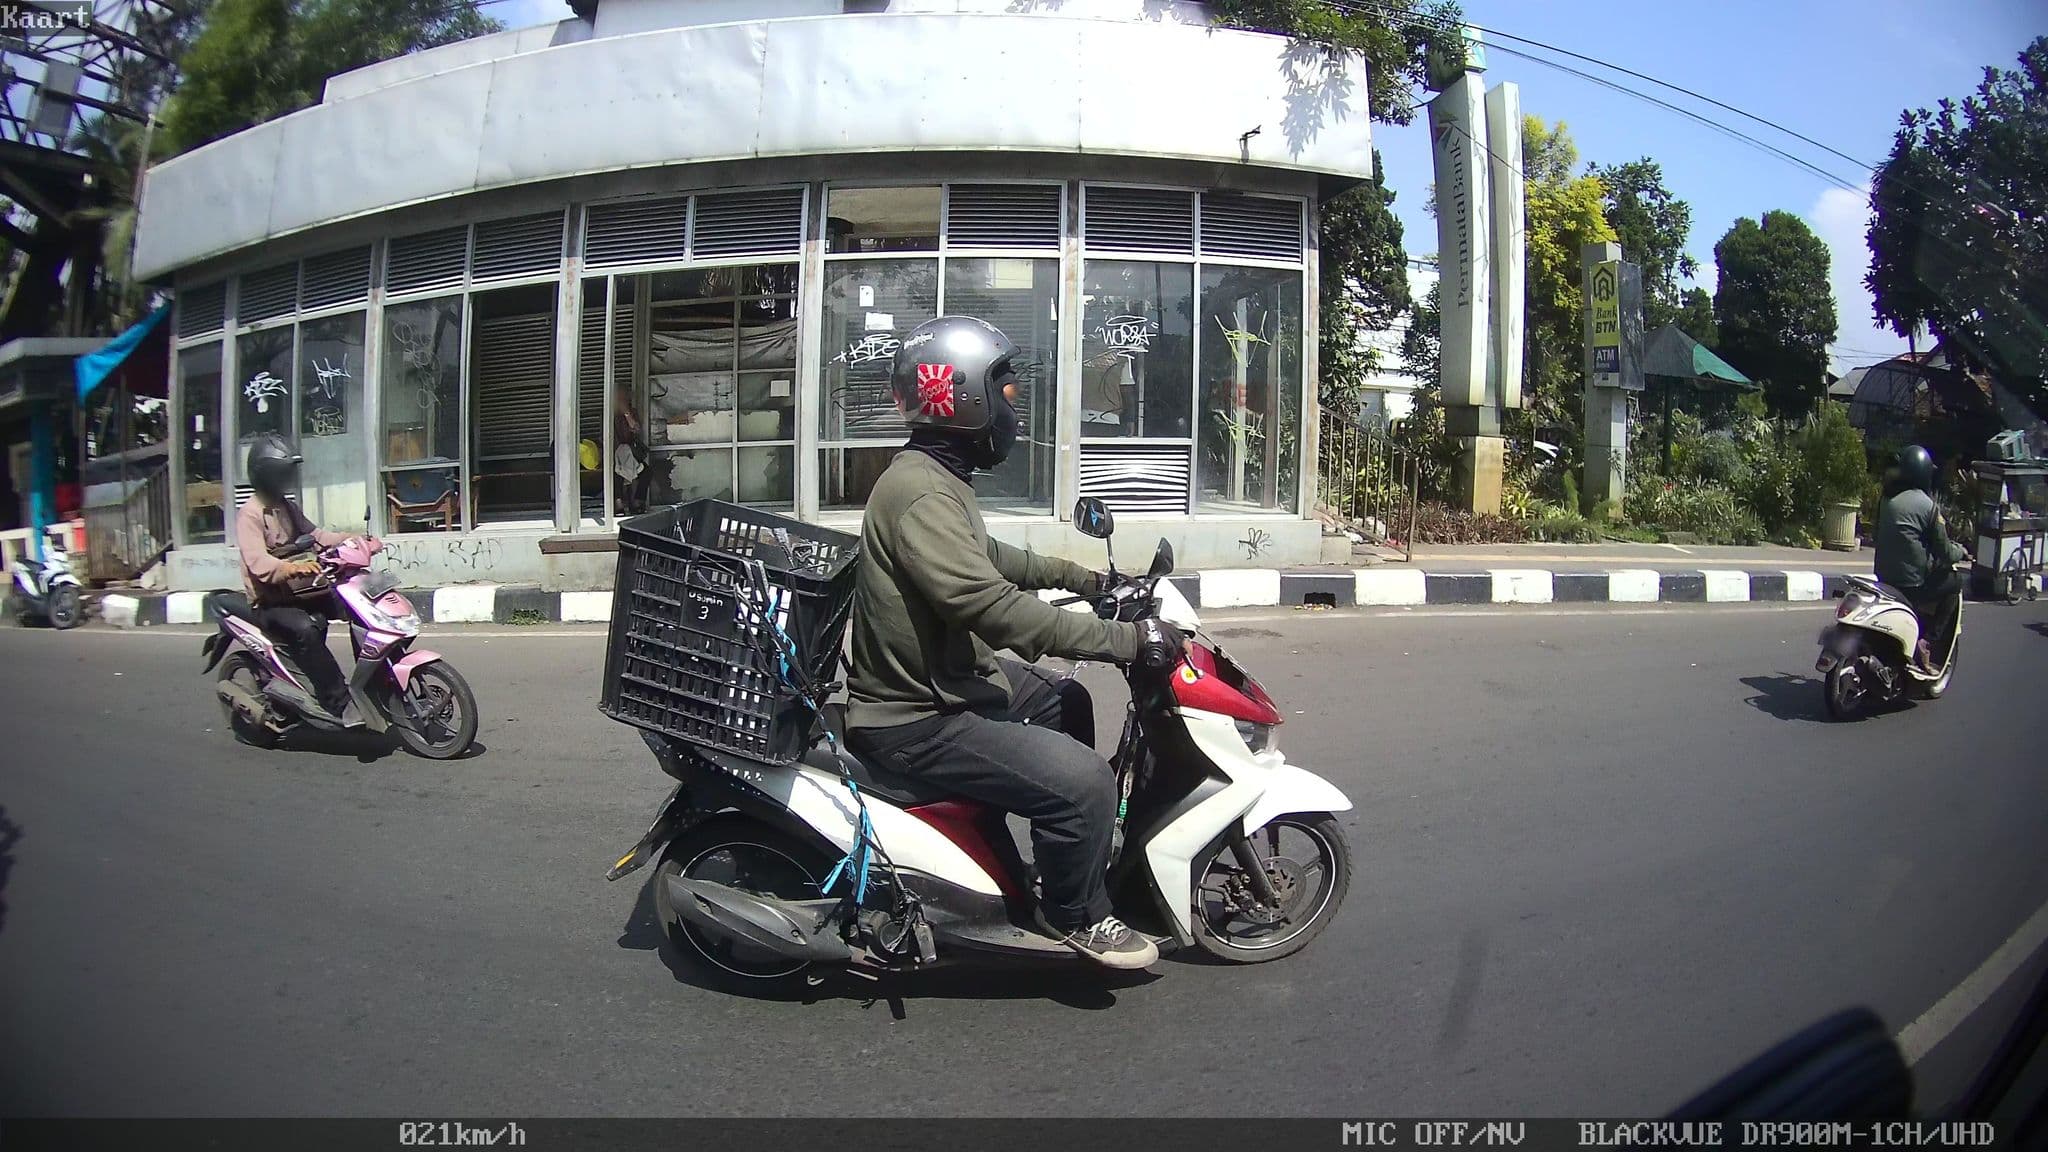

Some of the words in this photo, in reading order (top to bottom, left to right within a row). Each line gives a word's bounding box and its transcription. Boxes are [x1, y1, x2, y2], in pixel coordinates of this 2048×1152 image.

[1450, 136, 1469, 307] PermataBank
[1596, 305, 1618, 319] Bank
[1595, 321, 1616, 333] BTN
[1596, 349, 1615, 361] ATM
[697, 605, 709, 620] 3
